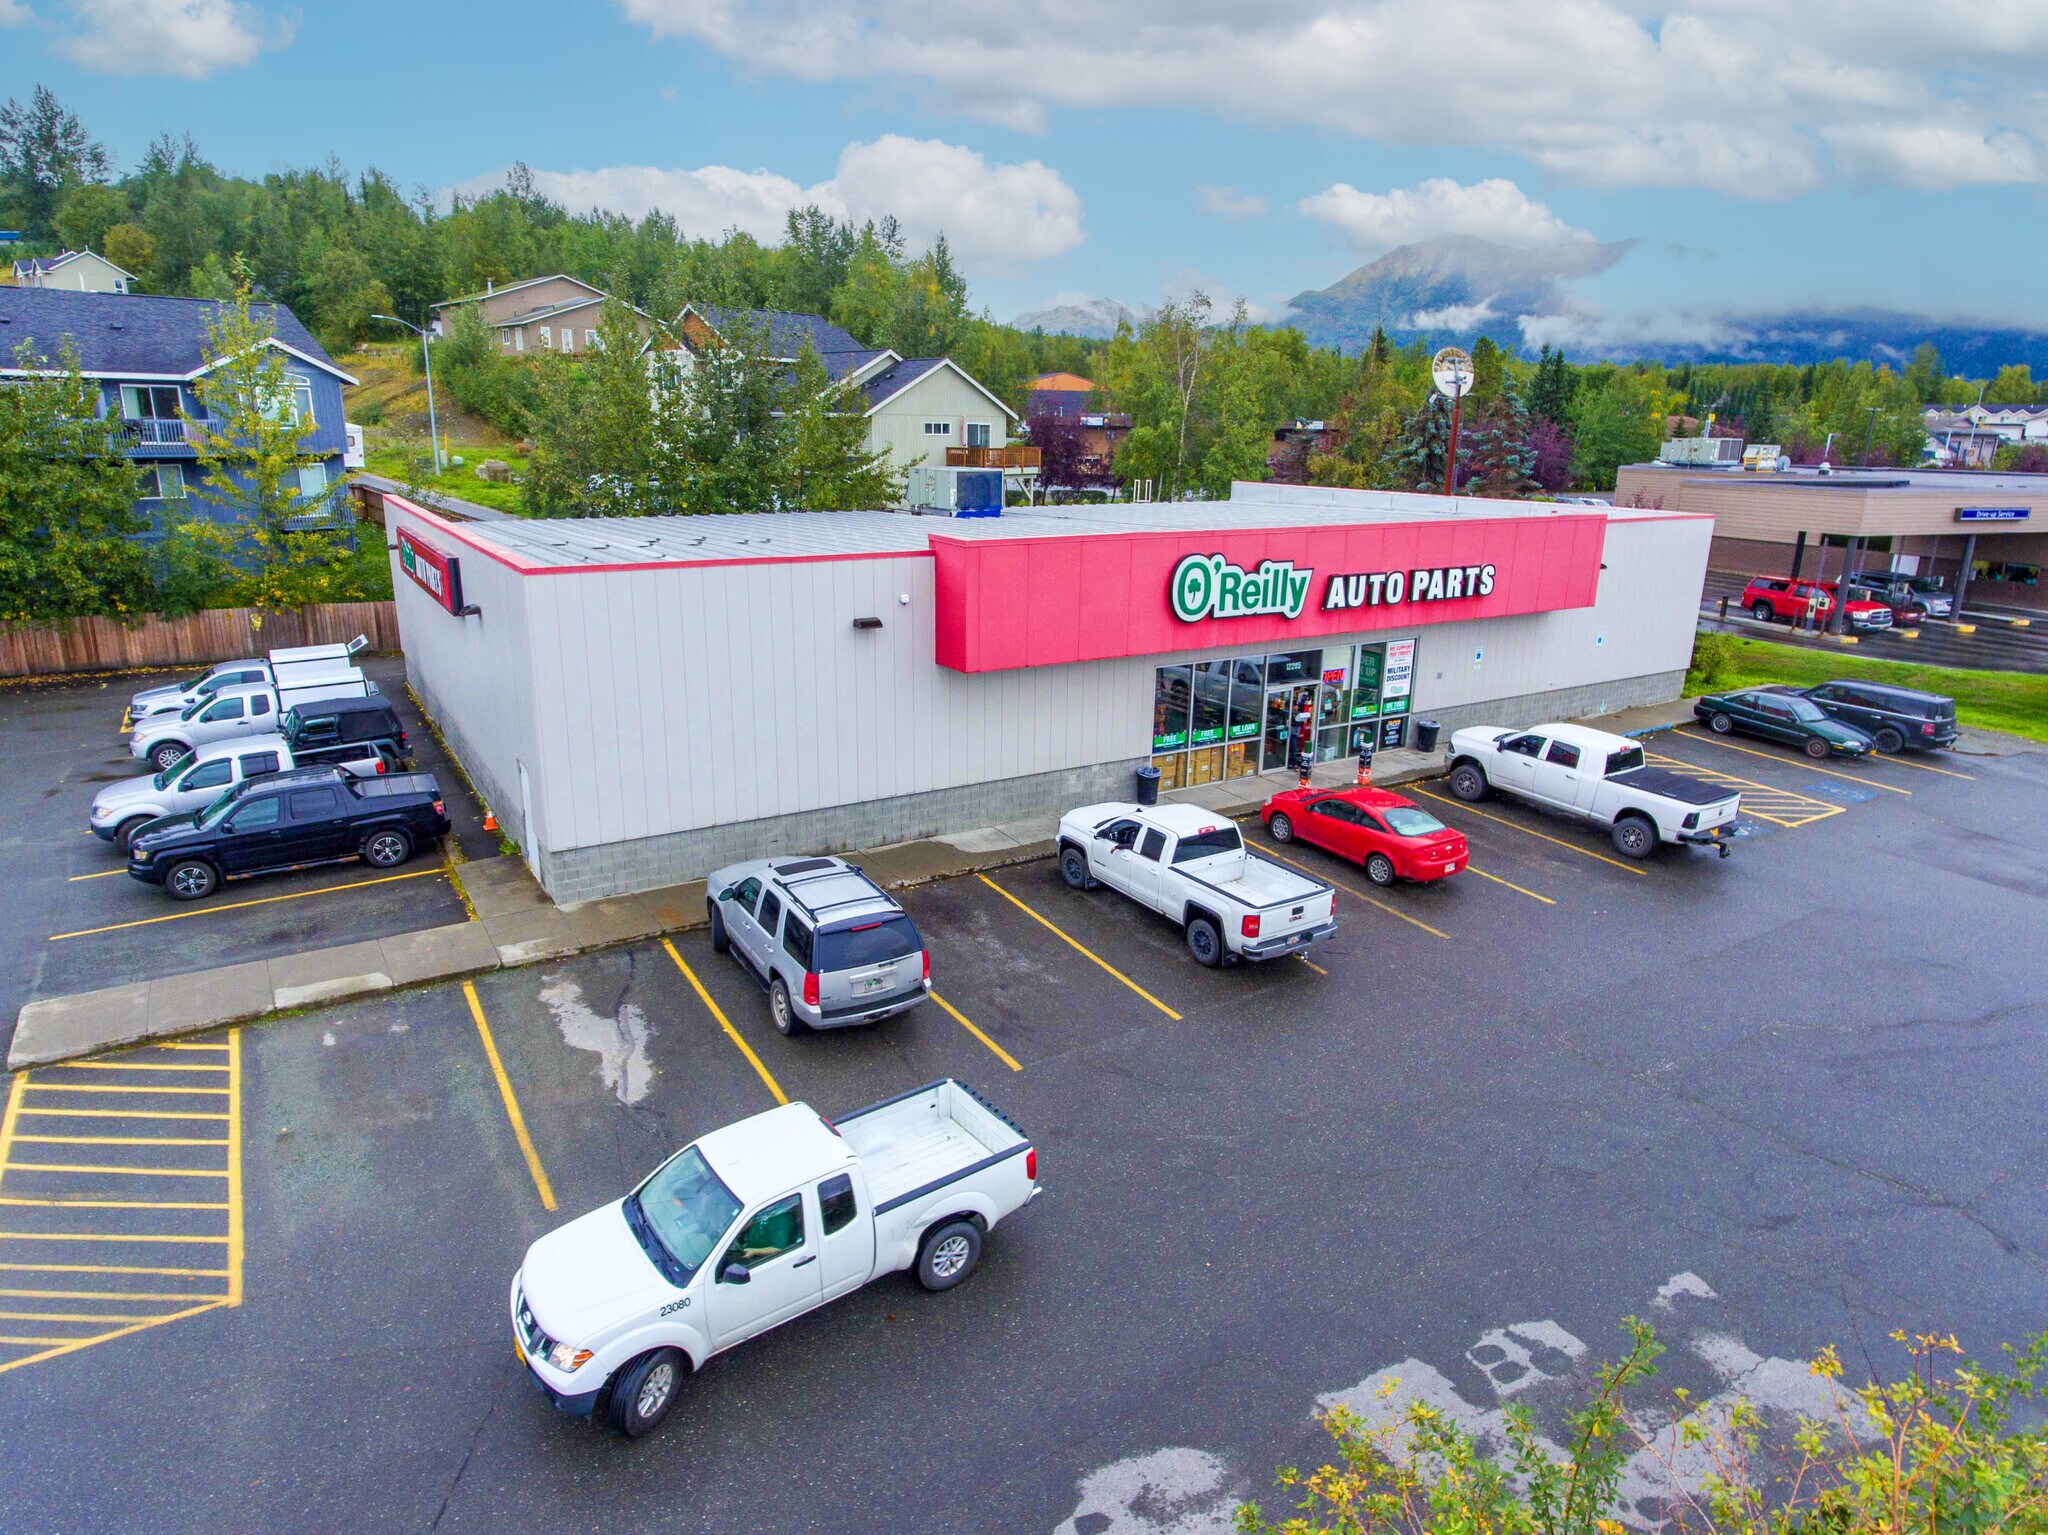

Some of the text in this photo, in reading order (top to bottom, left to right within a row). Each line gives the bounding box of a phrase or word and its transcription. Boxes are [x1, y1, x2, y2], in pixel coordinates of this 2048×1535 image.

[1998, 510, 2015, 518] Service
[1177, 560, 1496, 616] O'Reilly AUTO PARTS
[1387, 665, 1411, 674] MILITARY
[1386, 673, 1410, 682] DISCOUNT
[1200, 729, 1215, 738] FREE
[1163, 734, 1177, 743] FREE
[660, 1297, 692, 1317] 23080
